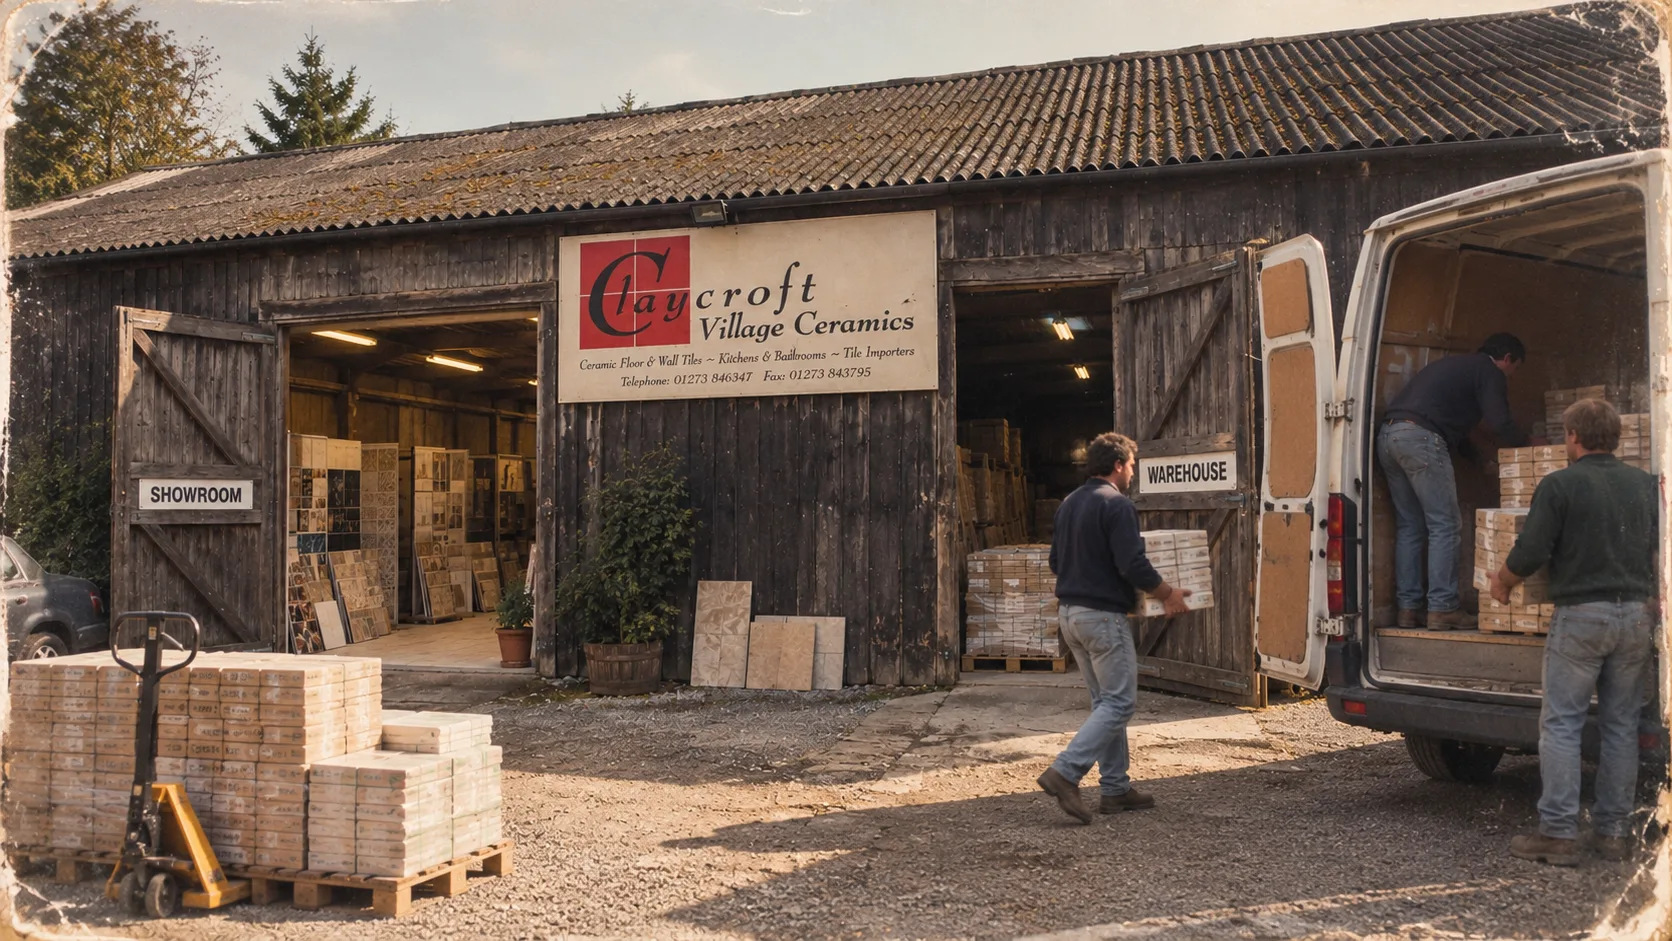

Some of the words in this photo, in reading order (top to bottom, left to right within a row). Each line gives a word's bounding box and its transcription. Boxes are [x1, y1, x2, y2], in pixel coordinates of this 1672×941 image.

[588, 247, 817, 337] Claycroft
[699, 311, 785, 343] Village
[794, 309, 915, 336] Ceramics
[579, 359, 617, 371] Ceramic
[619, 356, 645, 369] Floor
[646, 356, 656, 367] &
[658, 354, 680, 367] Wall
[681, 352, 702, 365] Tiles
[718, 350, 760, 364] Kitchens
[761, 350, 772, 363] &
[843, 346, 862, 359] Tile
[865, 345, 916, 360] Importers
[620, 375, 670, 388] Telephone:
[673, 373, 708, 385] 01273
[711, 371, 753, 384] 846347
[763, 370, 786, 382] Fax:
[789, 368, 825, 381] 01273
[827, 366, 872, 379] 843795
[1147, 460, 1228, 484] WAREHOUSE
[150, 486, 242, 503] SHOWROOM
